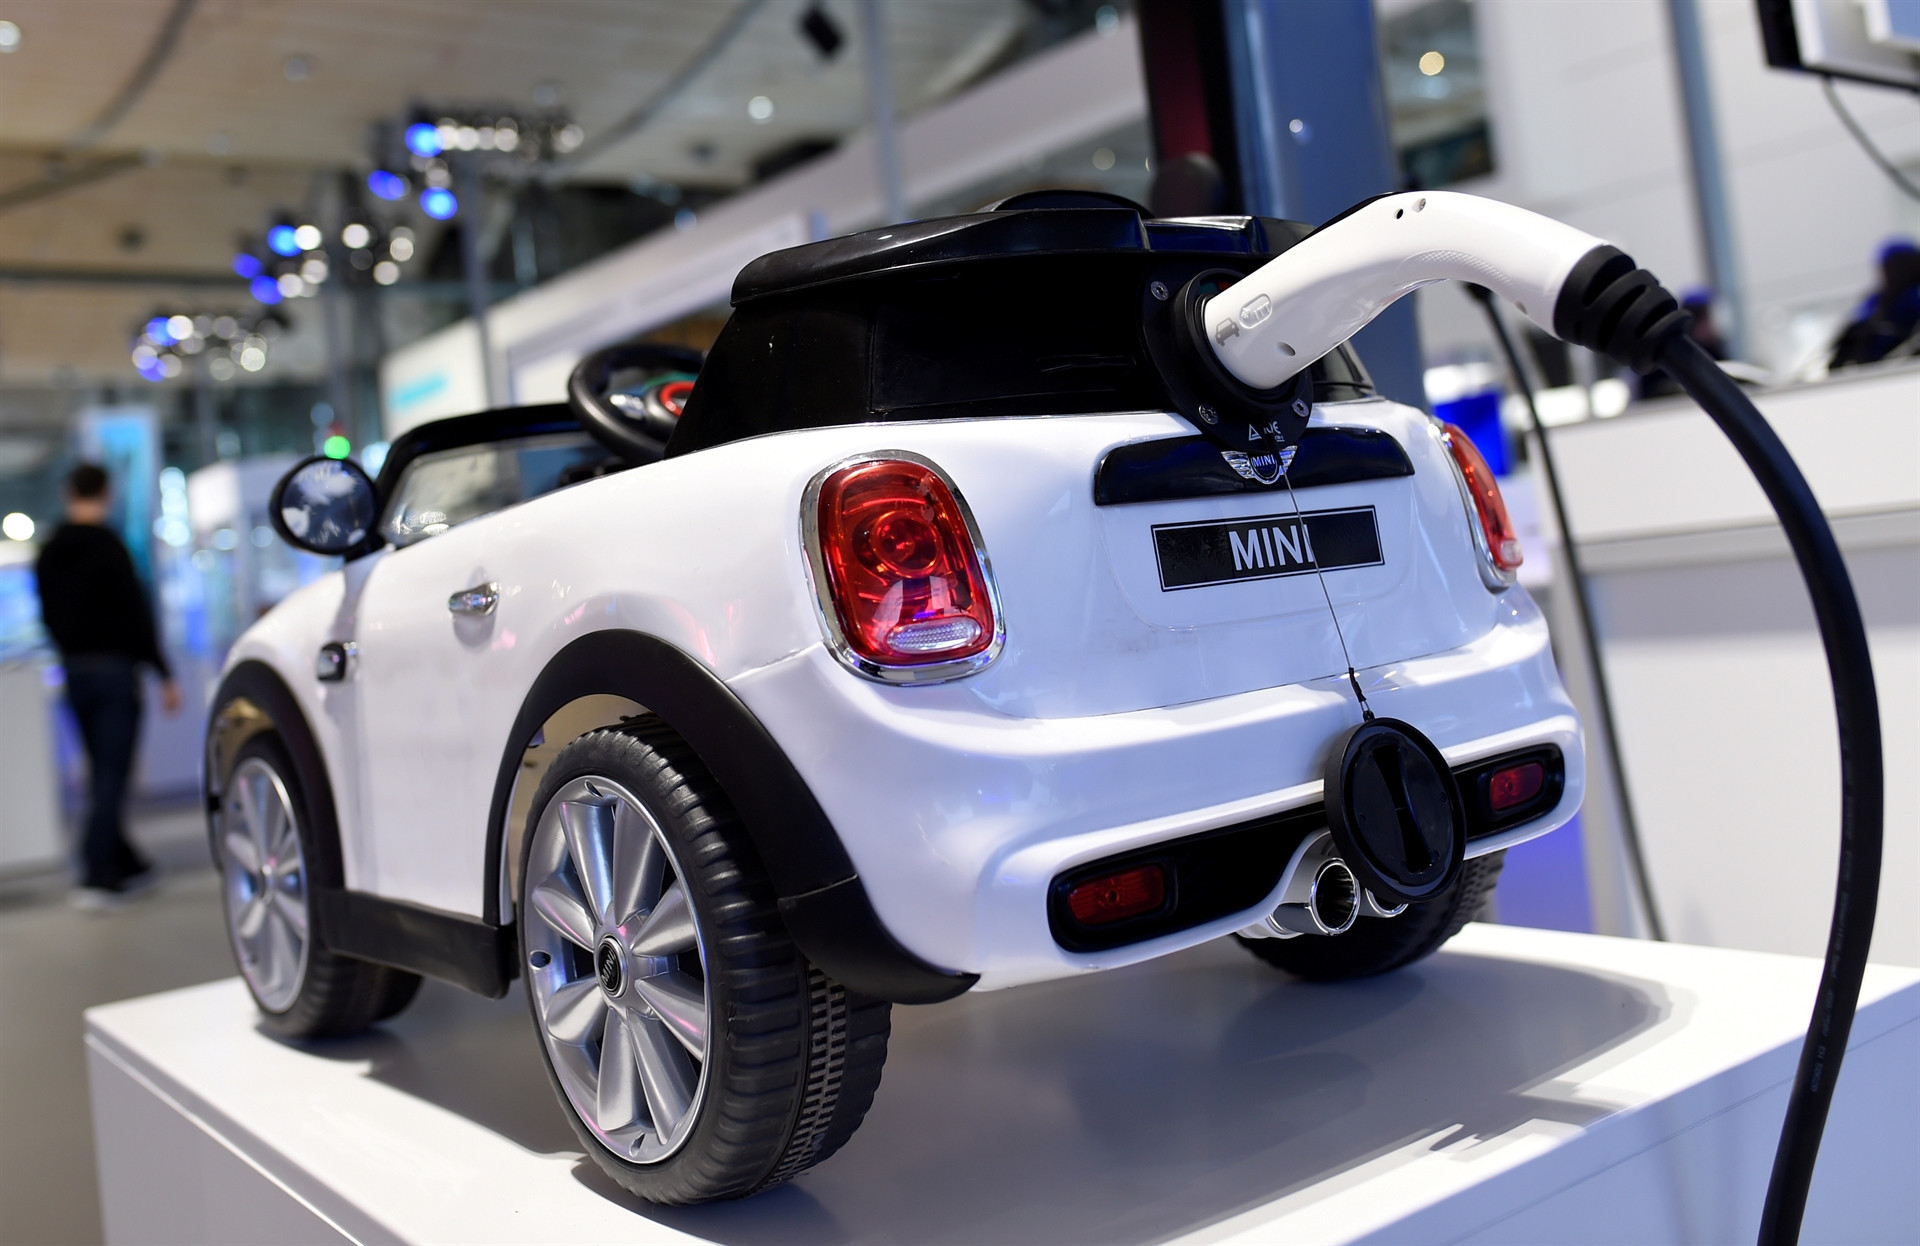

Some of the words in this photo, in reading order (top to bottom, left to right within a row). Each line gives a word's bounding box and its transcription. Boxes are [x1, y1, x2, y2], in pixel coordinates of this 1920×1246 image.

[1252, 454, 1276, 467] MINI
[1229, 524, 1315, 571] MINI
[601, 949, 616, 985] MINI
